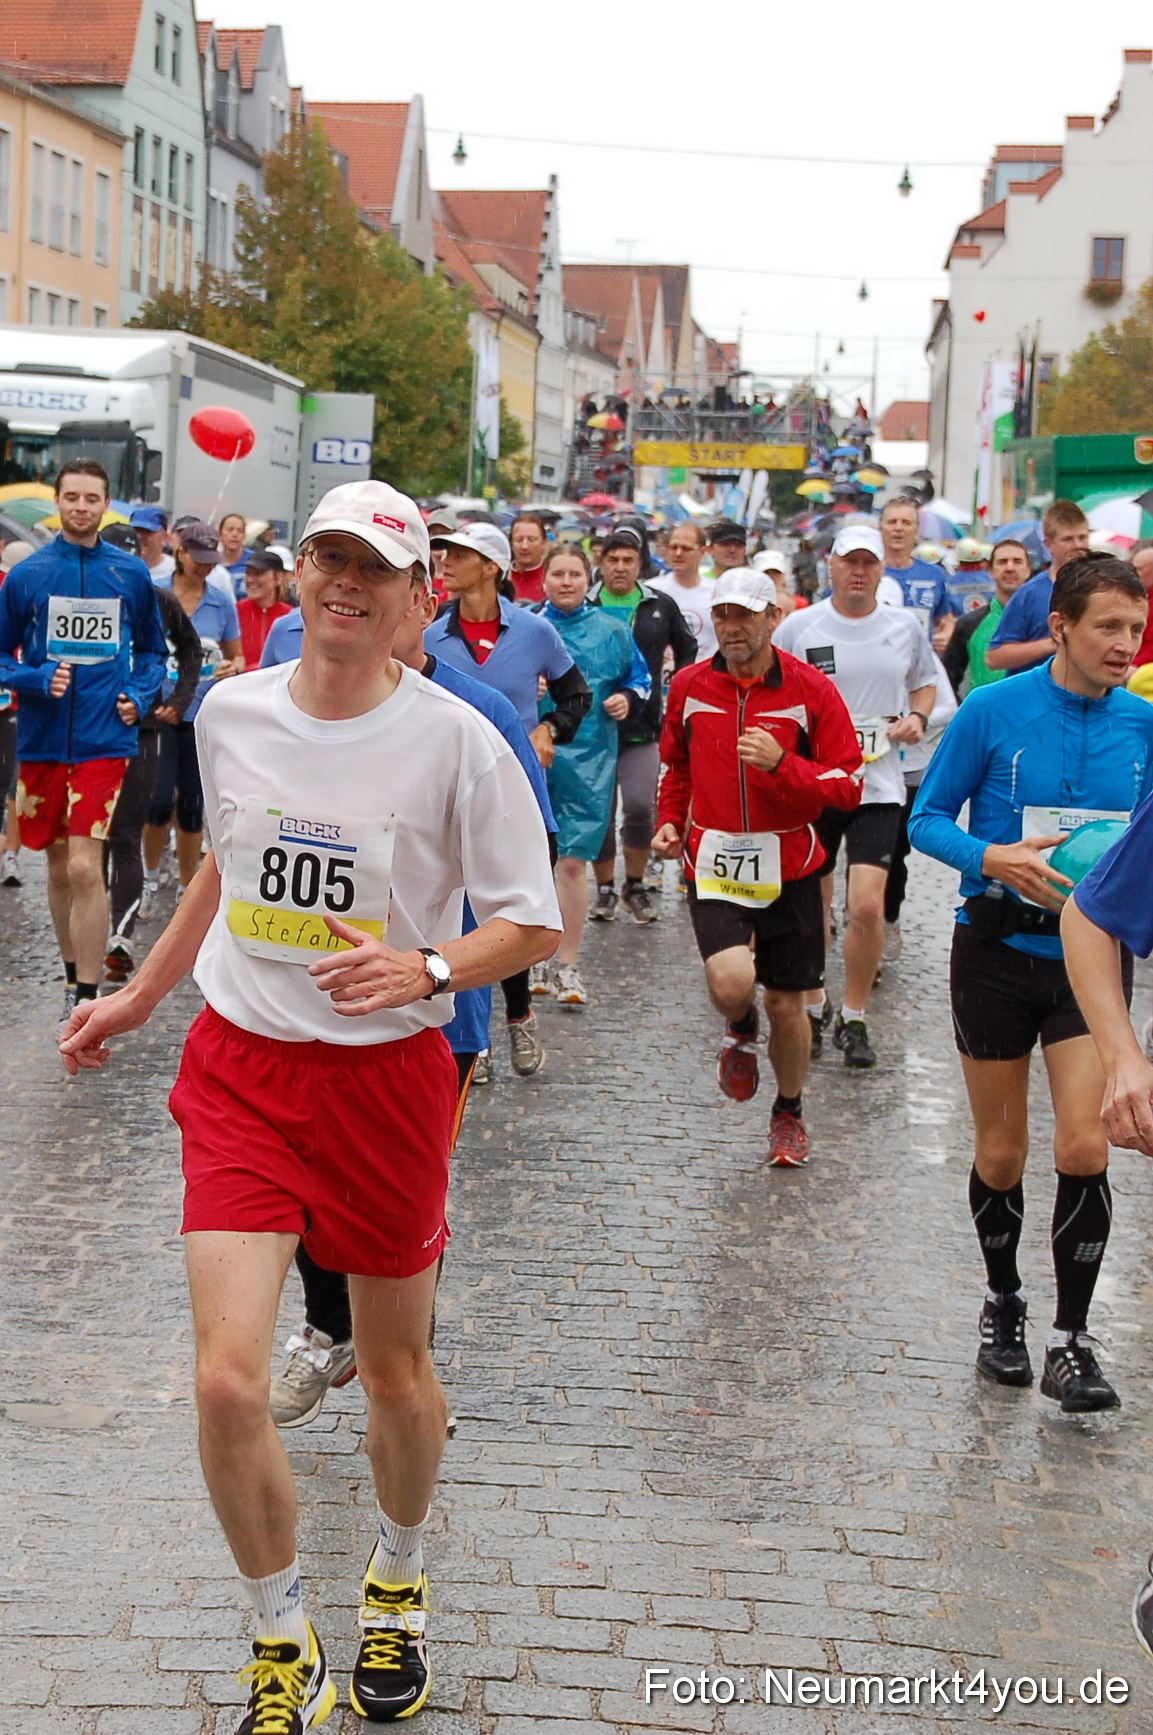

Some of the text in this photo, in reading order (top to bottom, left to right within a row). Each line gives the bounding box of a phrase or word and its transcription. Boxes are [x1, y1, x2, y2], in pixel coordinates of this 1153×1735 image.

[688, 447, 748, 464] START
[55, 614, 113, 641] 3025
[60, 644, 105, 656] Johannes
[279, 817, 342, 840] BOCK
[259, 846, 355, 914] 805
[713, 853, 760, 882] 571
[719, 883, 756, 898] Walter
[249, 908, 341, 949] Stefan
